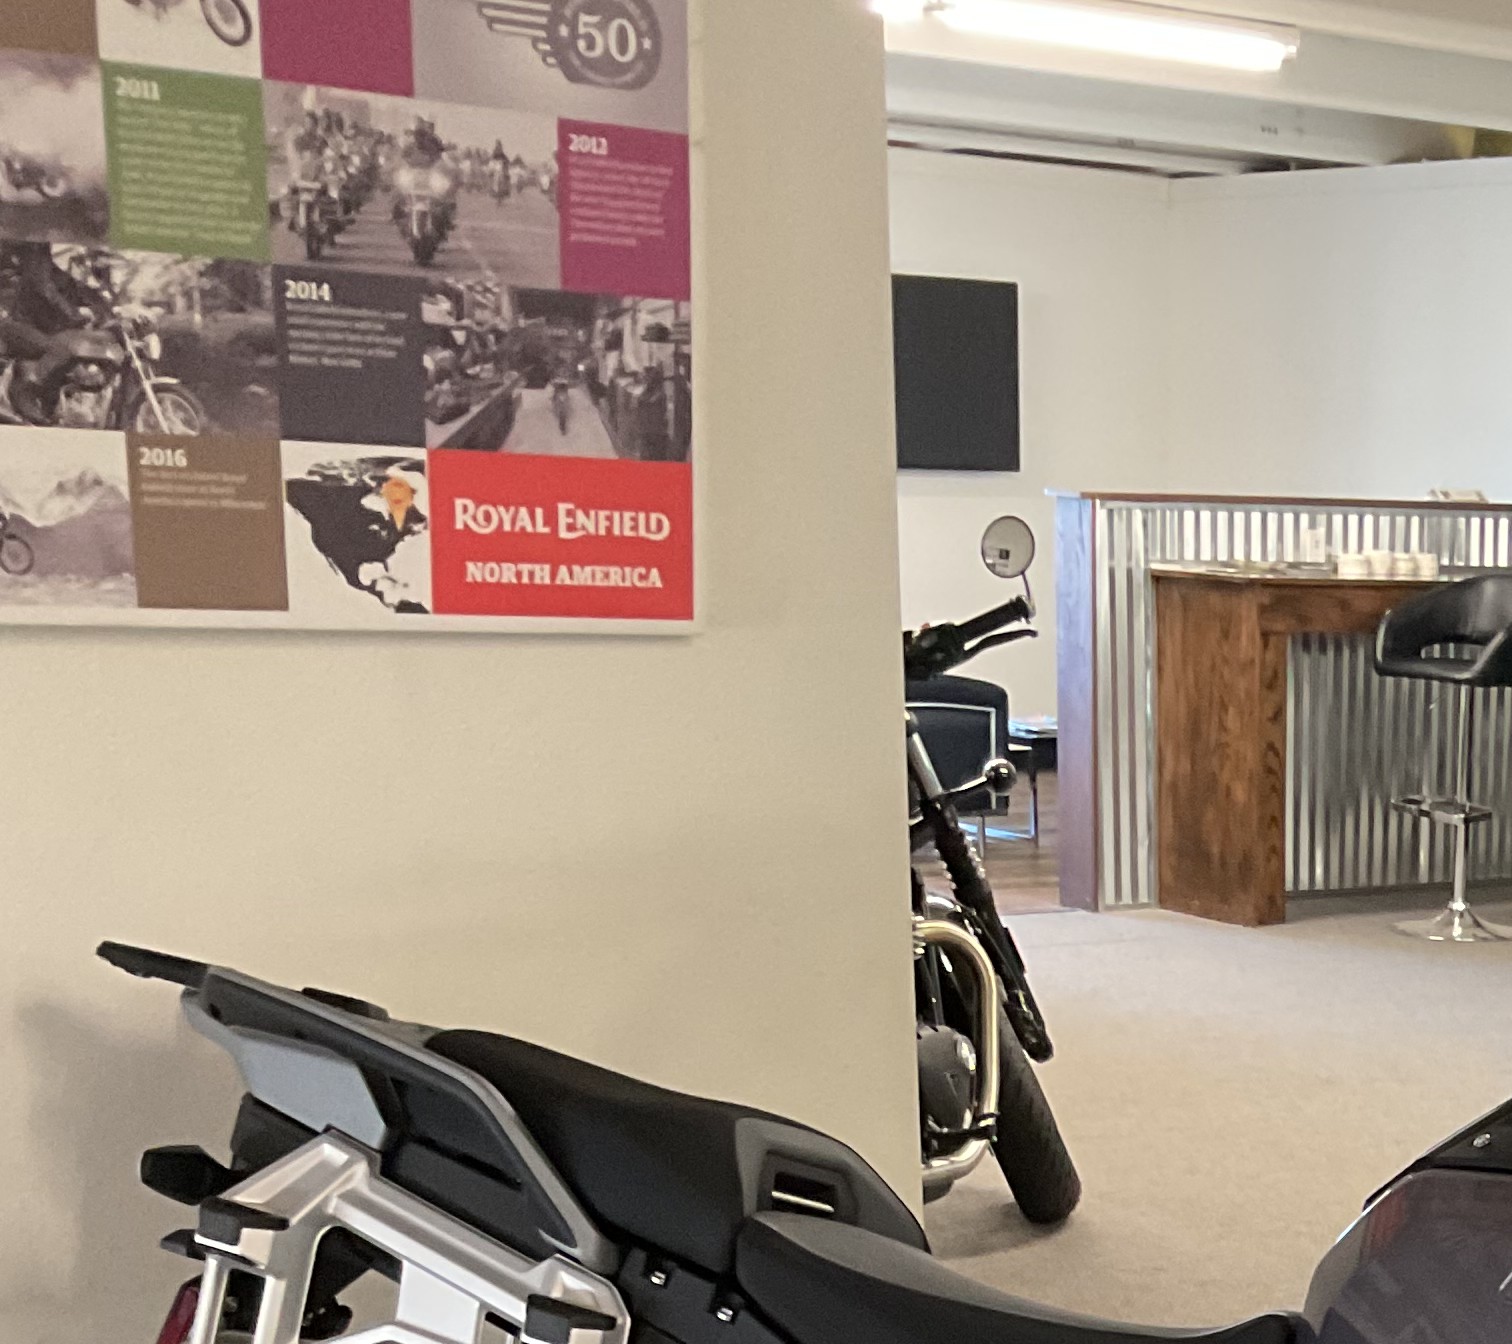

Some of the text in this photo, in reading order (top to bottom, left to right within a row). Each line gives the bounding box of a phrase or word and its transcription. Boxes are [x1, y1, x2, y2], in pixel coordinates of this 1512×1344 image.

[576, 12, 638, 63] 50
[284, 279, 332, 301] 2014
[139, 446, 187, 467] 2016
[465, 561, 663, 588] NORTH AMERICA
